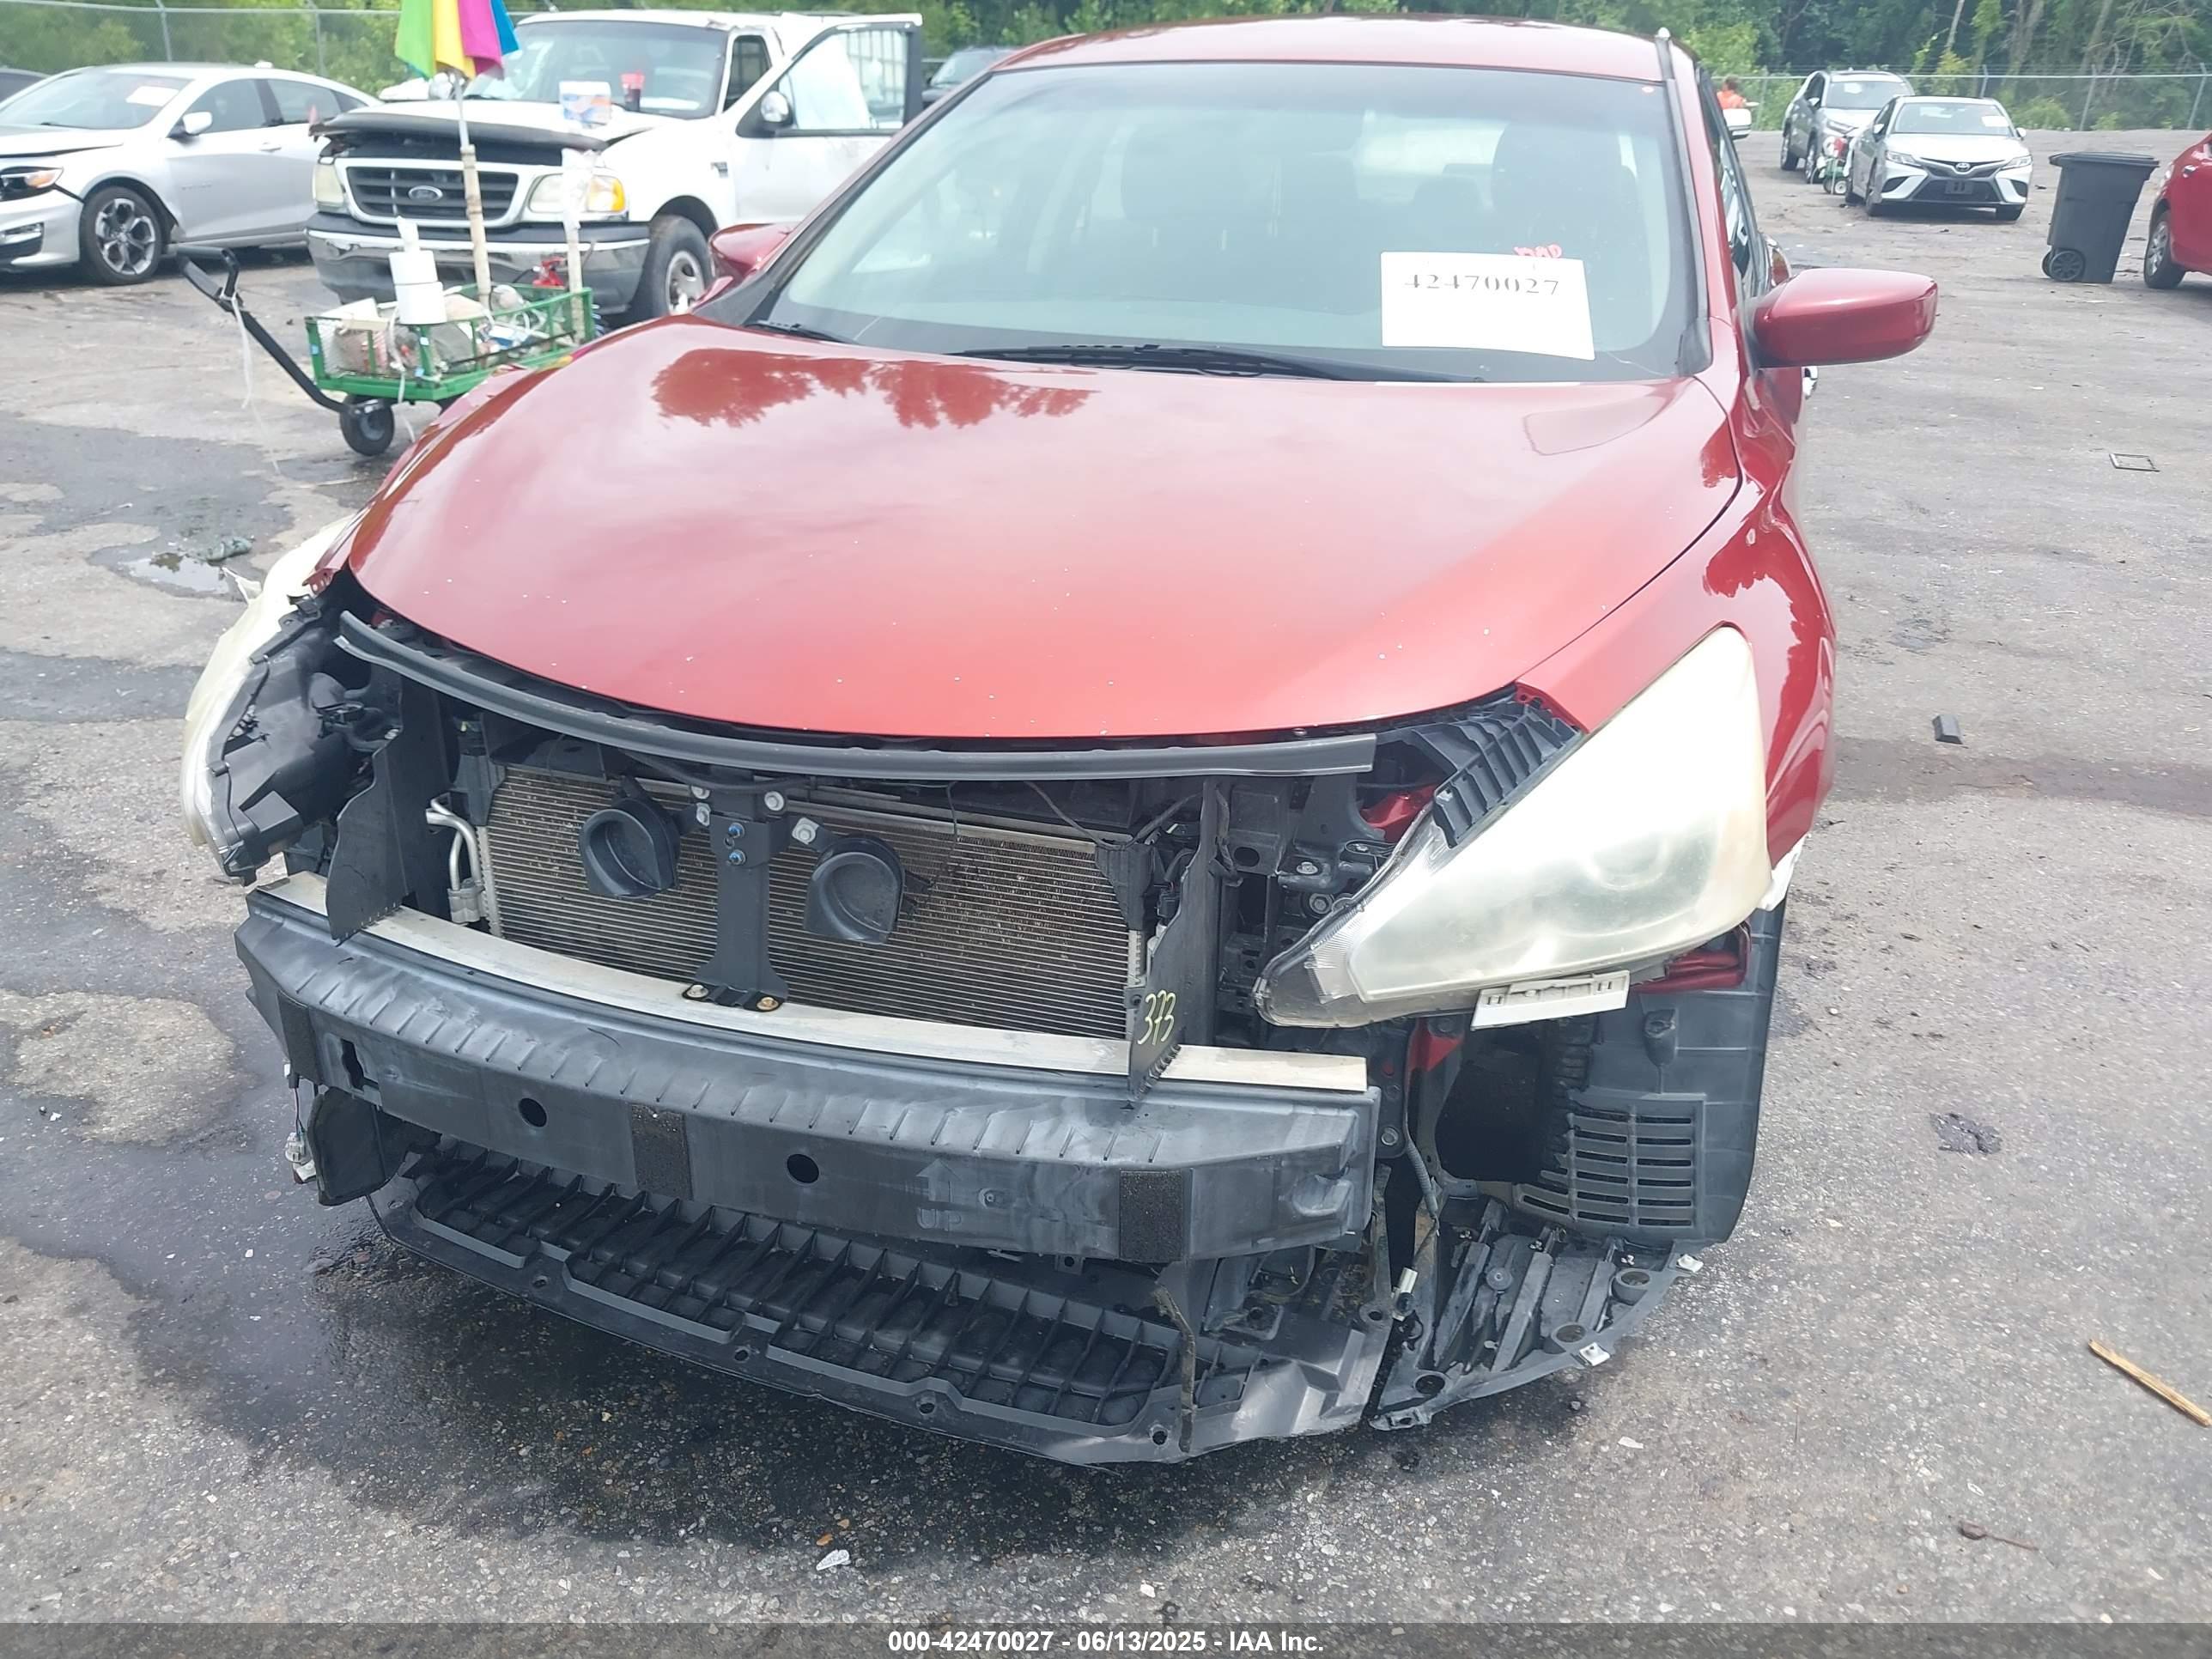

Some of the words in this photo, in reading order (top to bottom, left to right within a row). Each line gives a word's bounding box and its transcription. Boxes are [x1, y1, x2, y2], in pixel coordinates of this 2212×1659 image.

[1404, 273, 1559, 295] 42470027
[1137, 989, 1176, 1046] 373
[917, 1207, 962, 1231] UP
